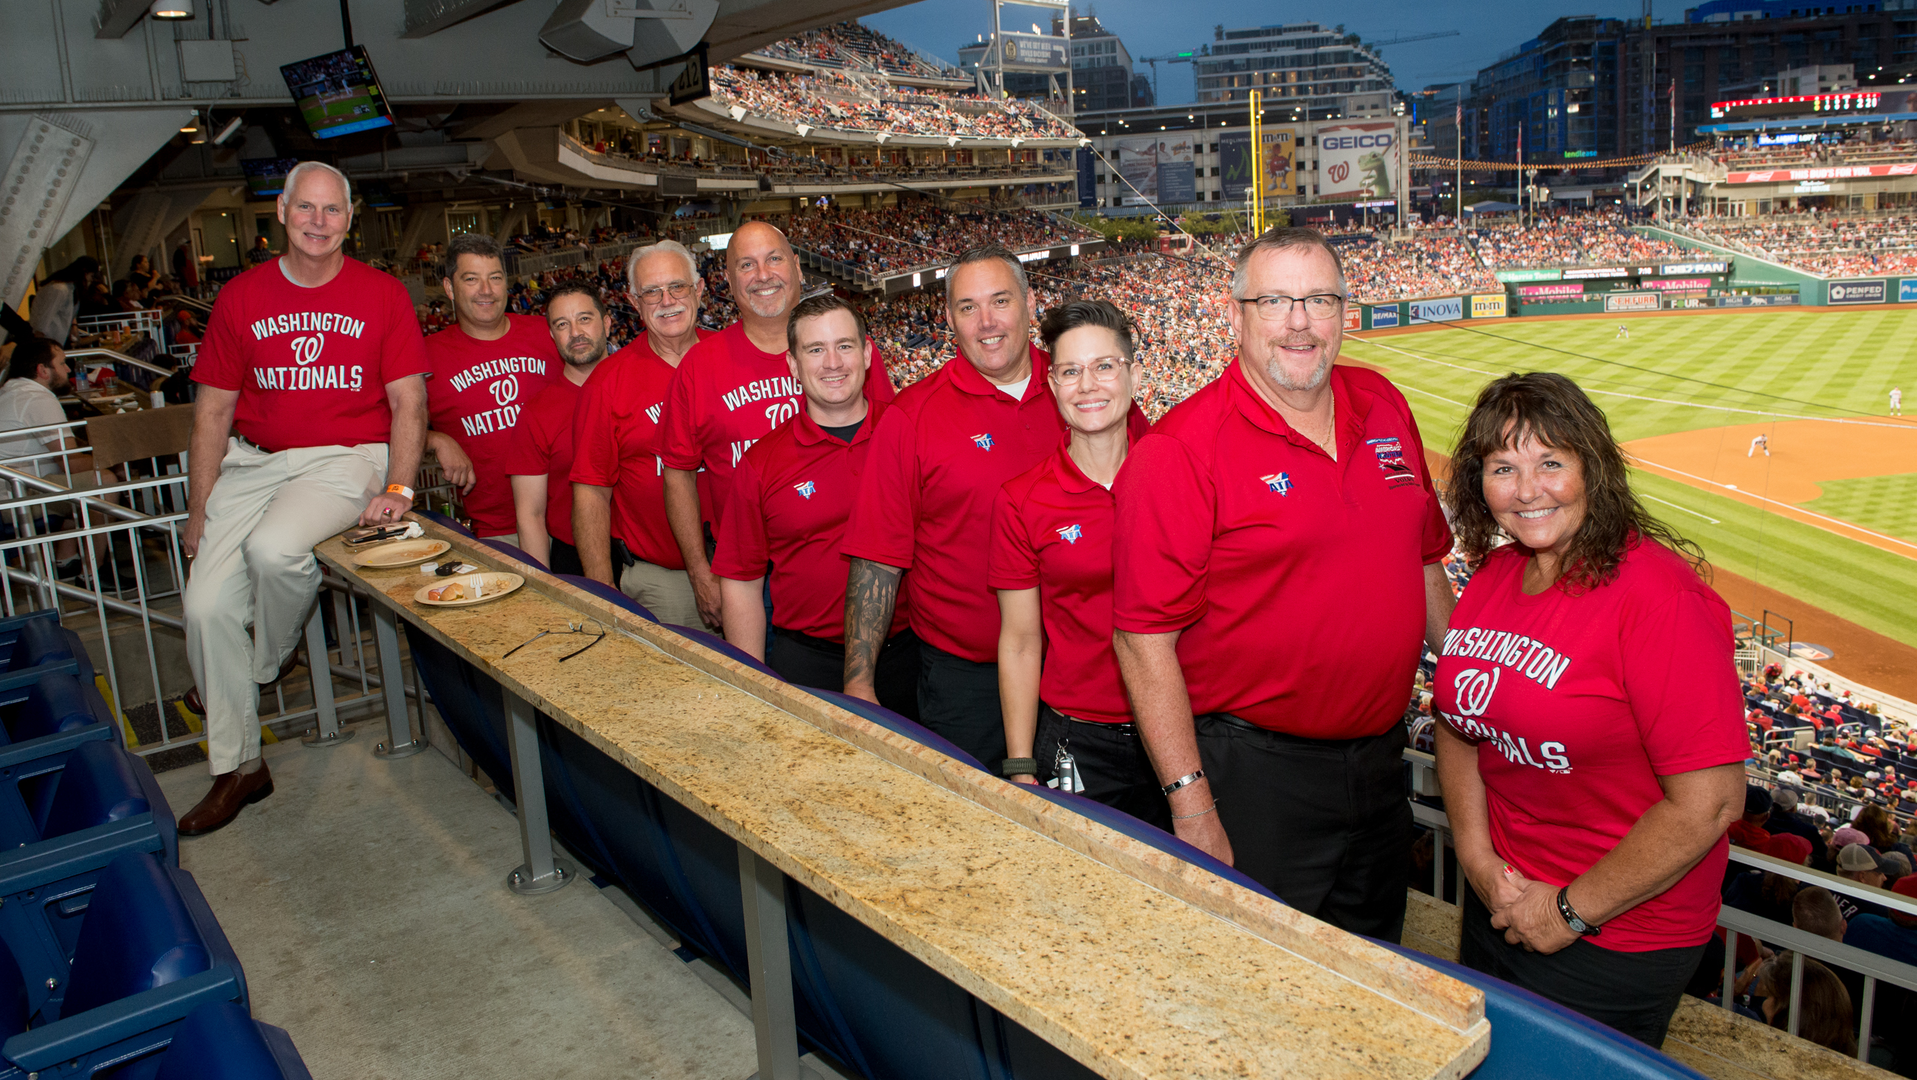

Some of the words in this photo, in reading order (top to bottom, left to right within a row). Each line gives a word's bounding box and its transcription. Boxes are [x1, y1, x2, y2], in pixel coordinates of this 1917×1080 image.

[1323, 134, 1392, 150] GEICO
[1327, 160, 1350, 184] W
[1790, 170, 1808, 179] THIS
[1810, 169, 1834, 178] BUD'S
[1835, 168, 1852, 177] FOR
[1853, 167, 1872, 176] YOU.
[1695, 263, 1724, 273] FAN
[1846, 286, 1883, 294] PENFED
[1345, 311, 1359, 319] UD'S
[1373, 312, 1397, 320] RE/MAX
[1423, 303, 1461, 318] INOVA
[251, 312, 365, 341] WASHINGTON
[1343, 320, 1354, 328] OU.
[291, 332, 325, 366] W
[254, 365, 363, 390] NATIONALS
[449, 356, 546, 393] WASHINGTON
[489, 374, 519, 406] W
[721, 376, 803, 412] WASHING
[1441, 627, 1572, 690] WASHINGTON
[1454, 666, 1500, 716] W
